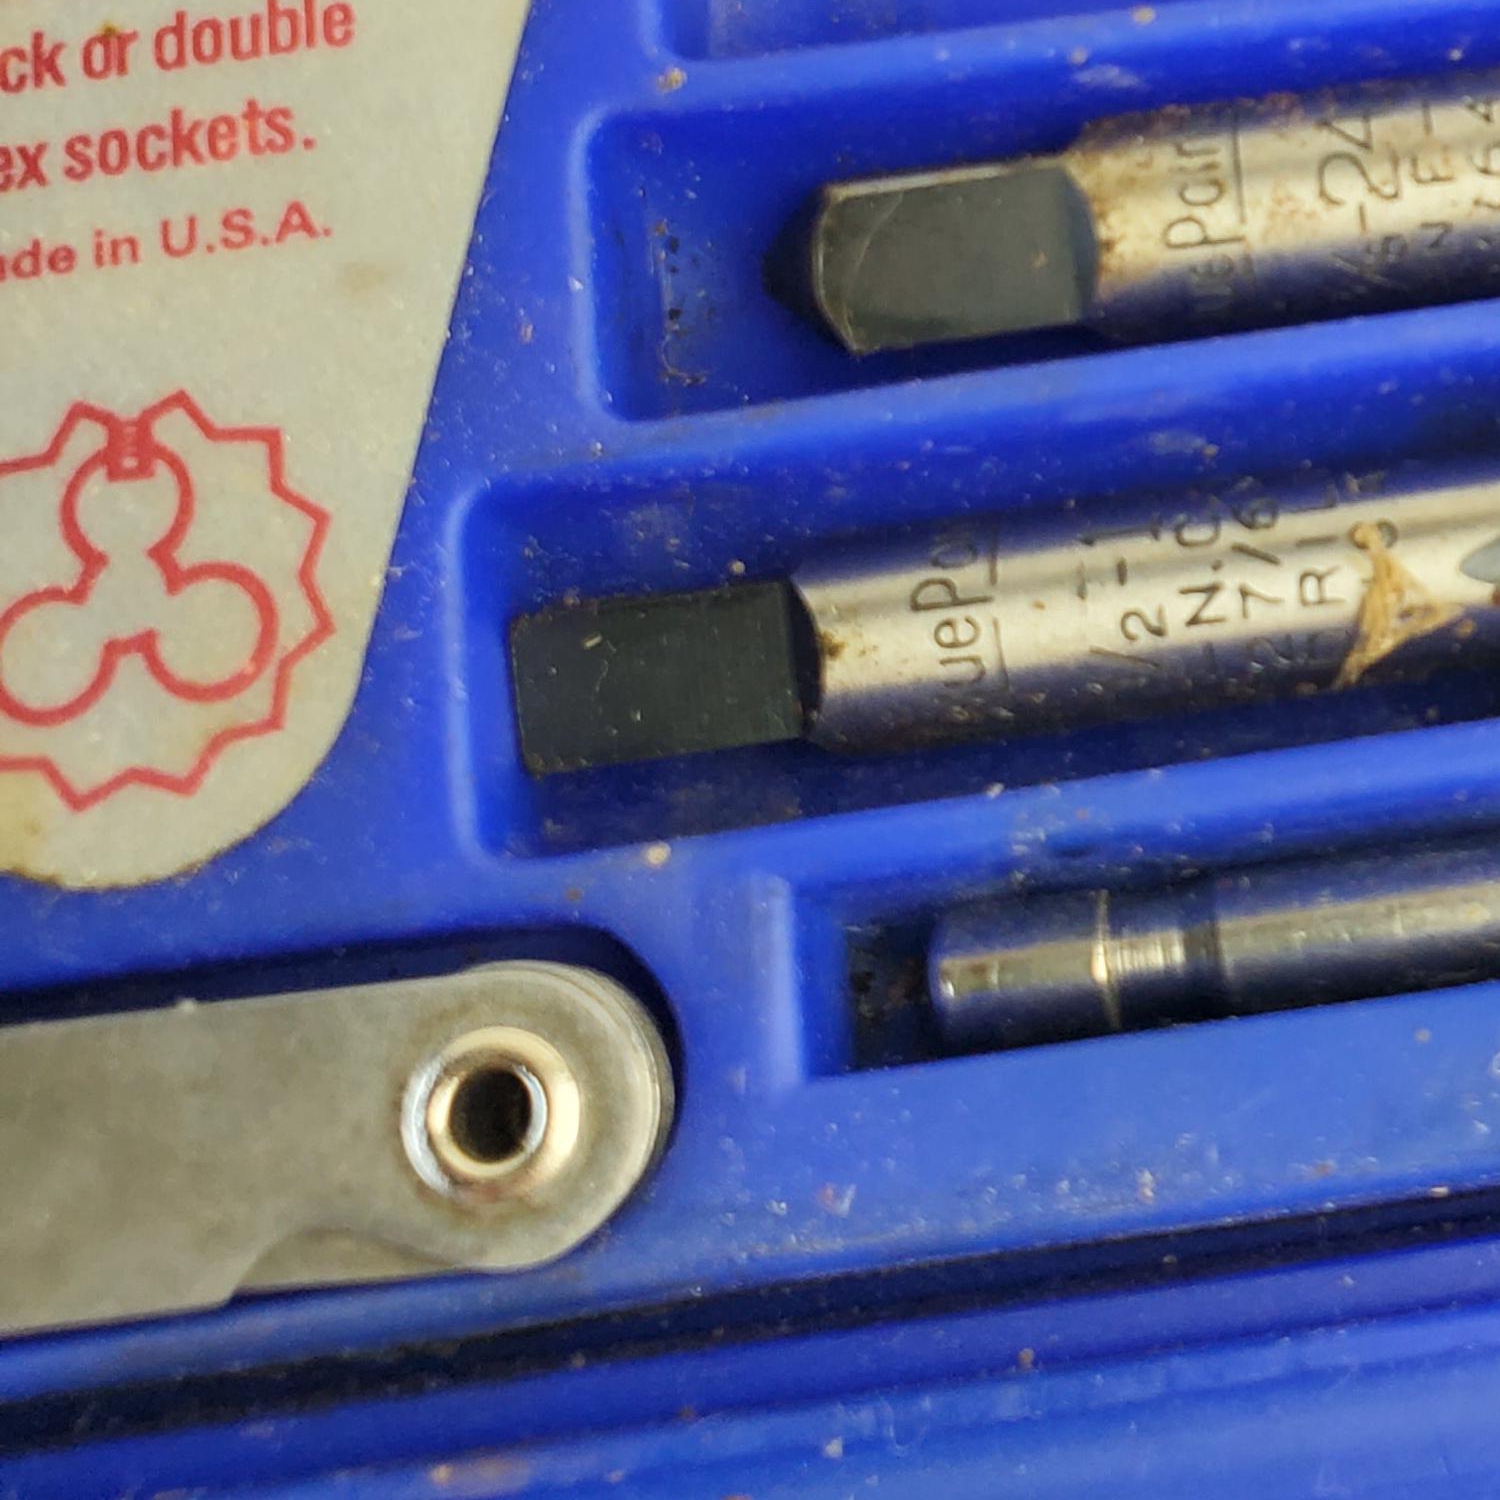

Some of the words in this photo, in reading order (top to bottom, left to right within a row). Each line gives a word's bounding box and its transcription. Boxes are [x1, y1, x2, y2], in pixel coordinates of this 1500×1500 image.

[80, 29, 139, 81] or
[63, 99, 316, 182] sockets.
[0, 238, 77, 283] de
[93, 229, 140, 267] in
[160, 200, 332, 258] U.S.A.
